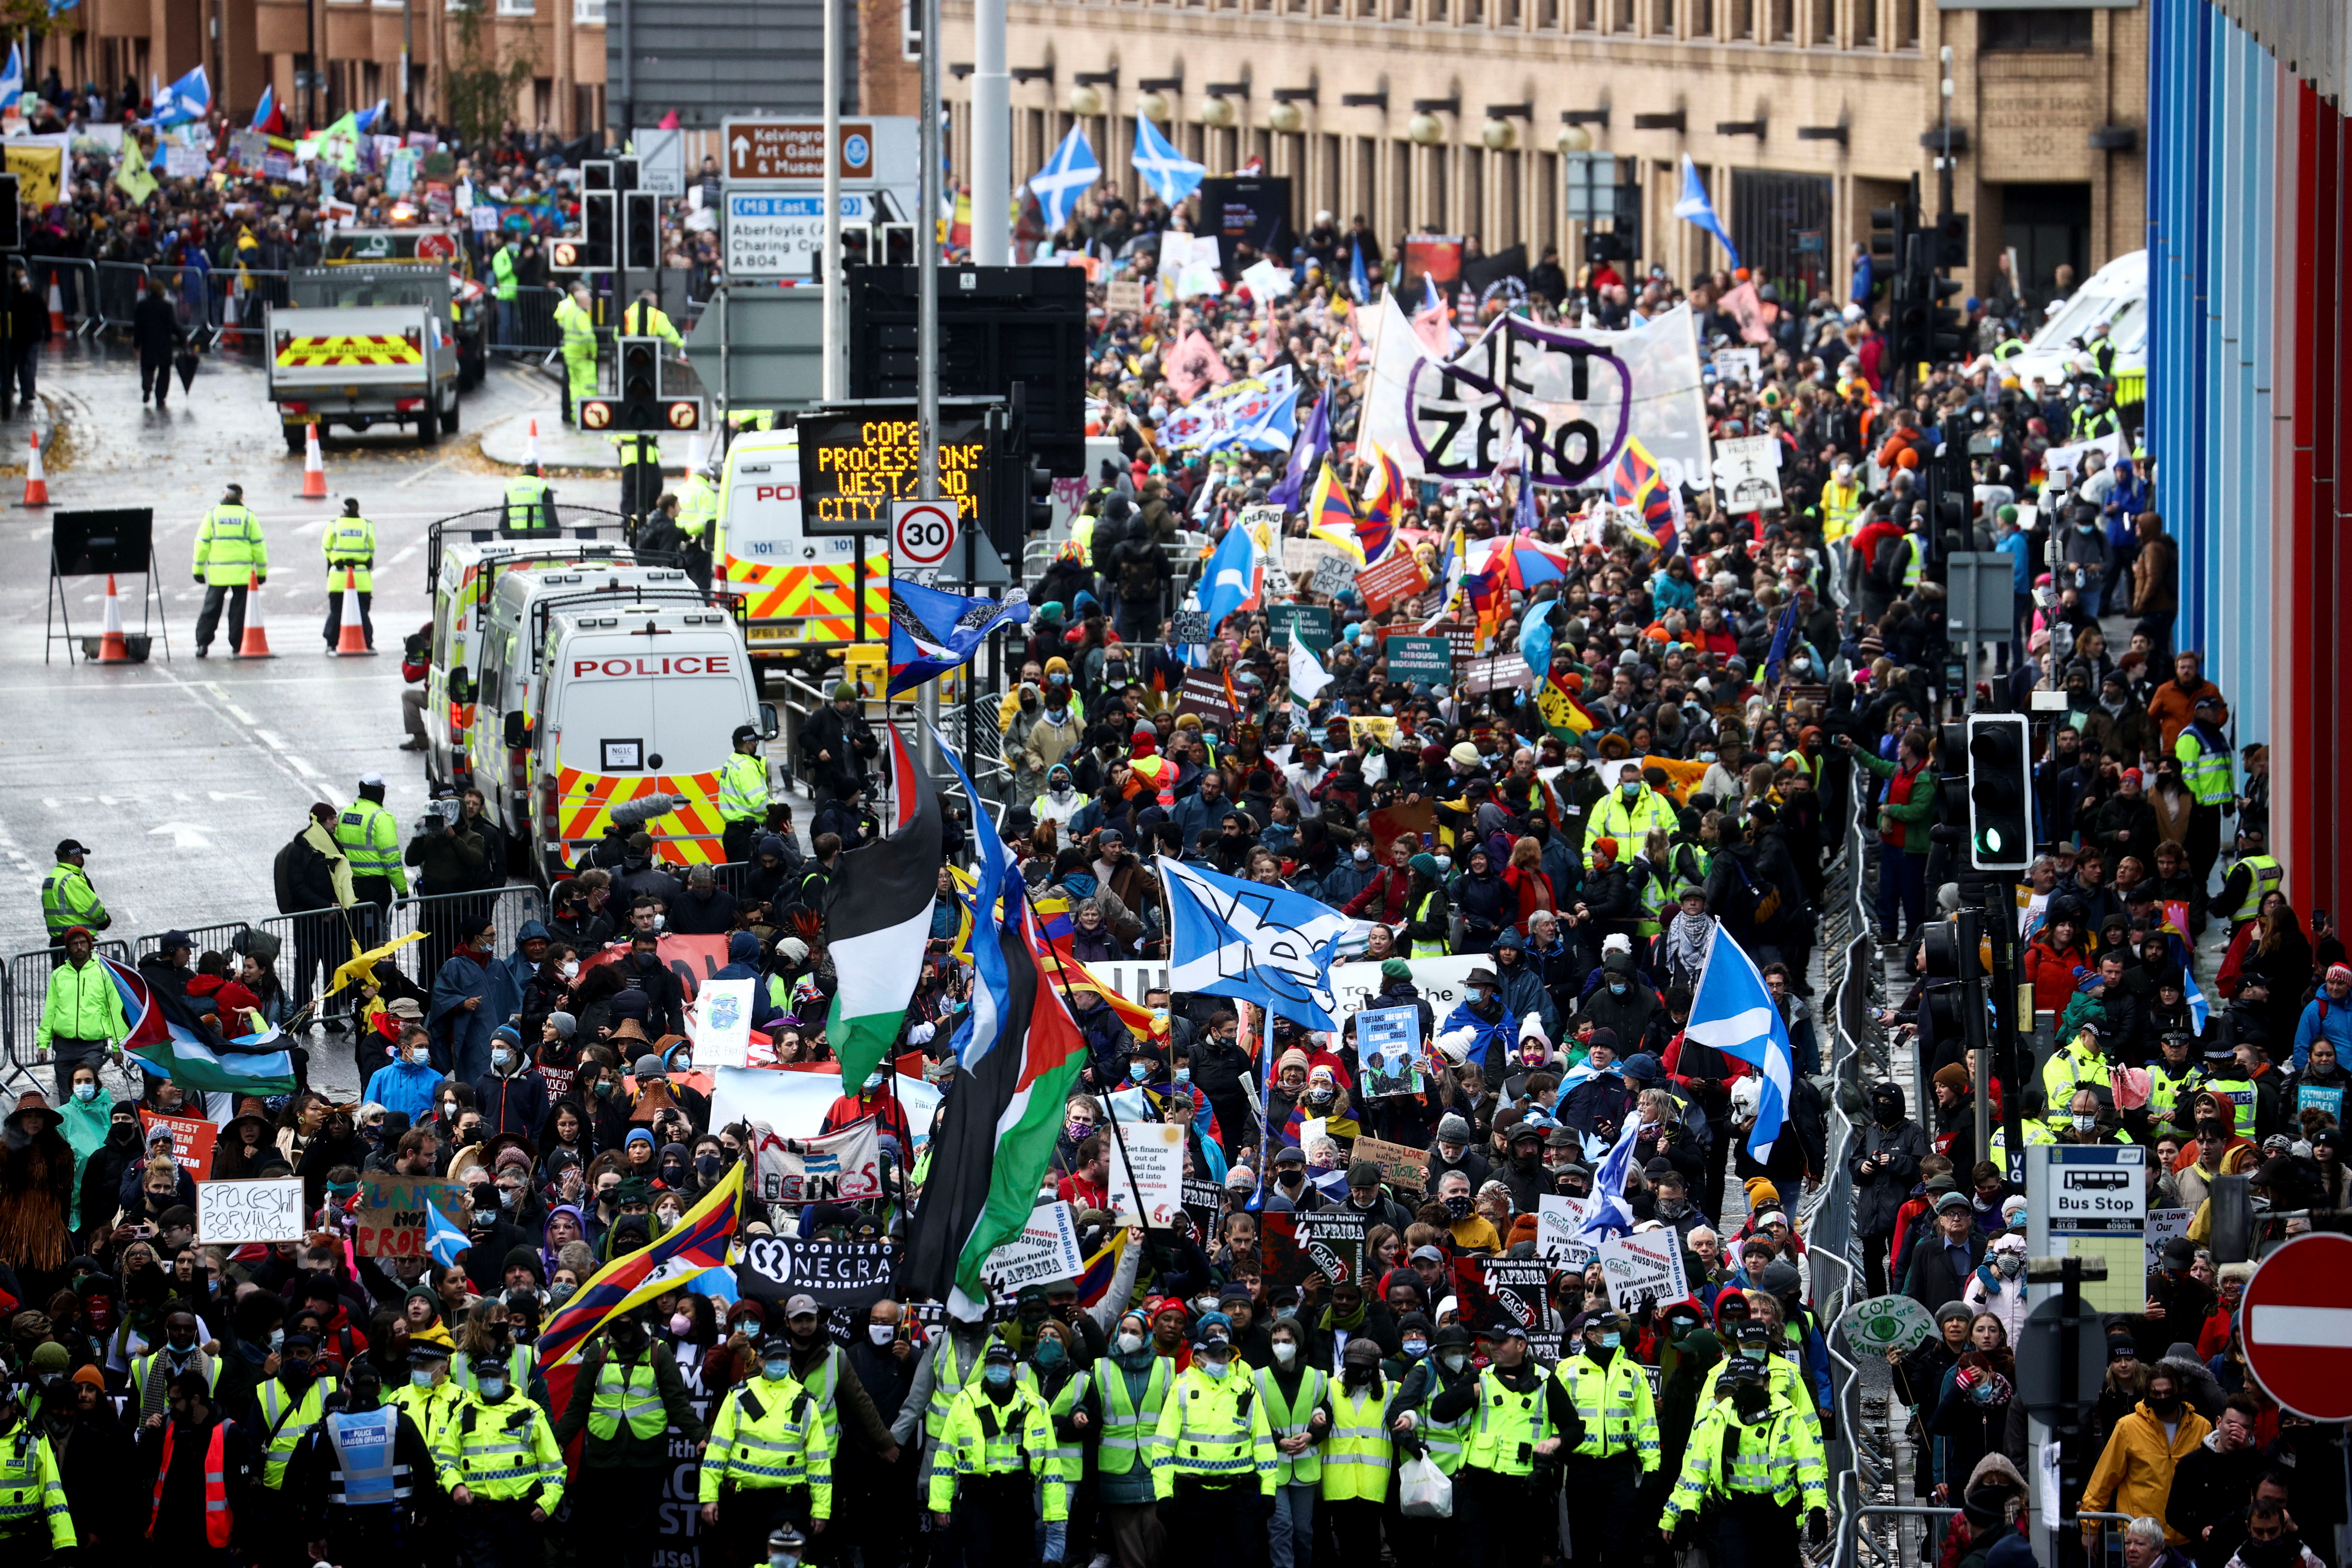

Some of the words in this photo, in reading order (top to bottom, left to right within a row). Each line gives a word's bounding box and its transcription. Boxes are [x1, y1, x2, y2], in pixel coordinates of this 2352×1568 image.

[754, 129, 824, 145] Kelvingro
[755, 144, 779, 157] Art
[785, 144, 824, 157] Galle
[757, 160, 769, 173] &
[775, 160, 824, 174] Museu
[775, 199, 811, 215] East,
[732, 223, 805, 238] Aberfoyle
[732, 239, 791, 253] Charing
[798, 239, 824, 251] Cro
[818, 444, 983, 471] PROCESSONS
[818, 497, 880, 521] CITY
[906, 523, 944, 546] 30
[754, 543, 772, 553] 101
[833, 540, 853, 550] 101
[1318, 556, 1351, 576] STOP
[1400, 651, 1439, 659] THROUGH
[574, 657, 730, 678] POLICE
[1390, 661, 1449, 669] BIODIVERSITY!
[1186, 677, 1225, 693] INDIGENOUS
[1183, 691, 1215, 706] CLIMATE
[1367, 723, 1393, 733] CLIMATE
[1361, 1014, 1384, 1024] TIBETANS
[1385, 1013, 1395, 1021] ARE
[1371, 1022, 1397, 1032] FRONTLINE
[702, 1032, 742, 1043] PLANET
[1369, 1032, 1390, 1042] CLIMATE
[1390, 1030, 1406, 1039] CRISIS
[696, 1045, 720, 1057] OVER
[539, 1065, 574, 1081] COLONIALISM
[546, 1078, 567, 1091] USED
[2227, 1092, 2251, 1103] OLICE
[148, 1117, 171, 1128] THE
[171, 1120, 199, 1134] BEST
[1303, 1121, 1323, 1132] CLIMATE
[759, 1132, 824, 1155] ALL
[1356, 1137, 1375, 1148] There
[1403, 1147, 1424, 1160] LOVE
[1376, 1152, 1403, 1163] without
[2012, 1154, 2022, 1169] V
[765, 1161, 878, 1200] BEINGS
[1391, 1164, 1422, 1181] JUSTICE
[2011, 1169, 2022, 1183] G
[362, 1180, 468, 1212] PLANET
[1181, 1187, 1219, 1210] FRICA
[2059, 1196, 2089, 1210] Bus
[2095, 1196, 2134, 1212] Stop
[393, 1210, 427, 1228] NOT
[1547, 1213, 1570, 1232] PACJA
[2150, 1213, 2163, 1222] We
[2166, 1212, 2186, 1221] Love
[1024, 1227, 1059, 1239] aseaten
[1294, 1221, 1311, 1249] 4
[1311, 1223, 1366, 1240] AFRICA
[2156, 1222, 2173, 1232] Our
[358, 1226, 447, 1258] PROF
[1016, 1235, 1058, 1248] SD100B?
[1054, 1205, 1079, 1273] #BlaBlaBlaBla!
[2074, 1239, 2080, 1247] 2
[794, 1242, 893, 1255] COALIZÃO
[1546, 1244, 1561, 1268] 4
[1562, 1247, 1595, 1265] AFR
[1621, 1240, 1670, 1264] #Whohaseaten
[794, 1256, 891, 1279] NEGRA
[1313, 1246, 1342, 1279] PACJA
[1609, 1261, 1631, 1274] PACJA
[1631, 1254, 1670, 1273] #USD100B?
[1665, 1230, 1685, 1298] #BlaBlaBlaBla!
[794, 1278, 822, 1289] POR
[826, 1275, 890, 1289] DIREITOS
[990, 1271, 1006, 1295] 4
[1007, 1258, 1063, 1285] AFRICA
[1483, 1268, 1498, 1295] 4
[1499, 1269, 1547, 1285] AFRICA
[1502, 1291, 1530, 1322] PACJA
[1539, 1287, 1551, 1331] #WECANTBREATH
[1619, 1290, 1632, 1314] 4
[1857, 1298, 1895, 1321] COP
[1896, 1305, 1915, 1317] are
[1905, 1318, 1931, 1346] YOU
[765, 1339, 782, 1348] POLICE
[342, 1436, 364, 1446] LIAISON
[364, 1434, 386, 1444] OFFICER
[354, 1429, 373, 1437] POLICE
[668, 1439, 695, 1458] ith
